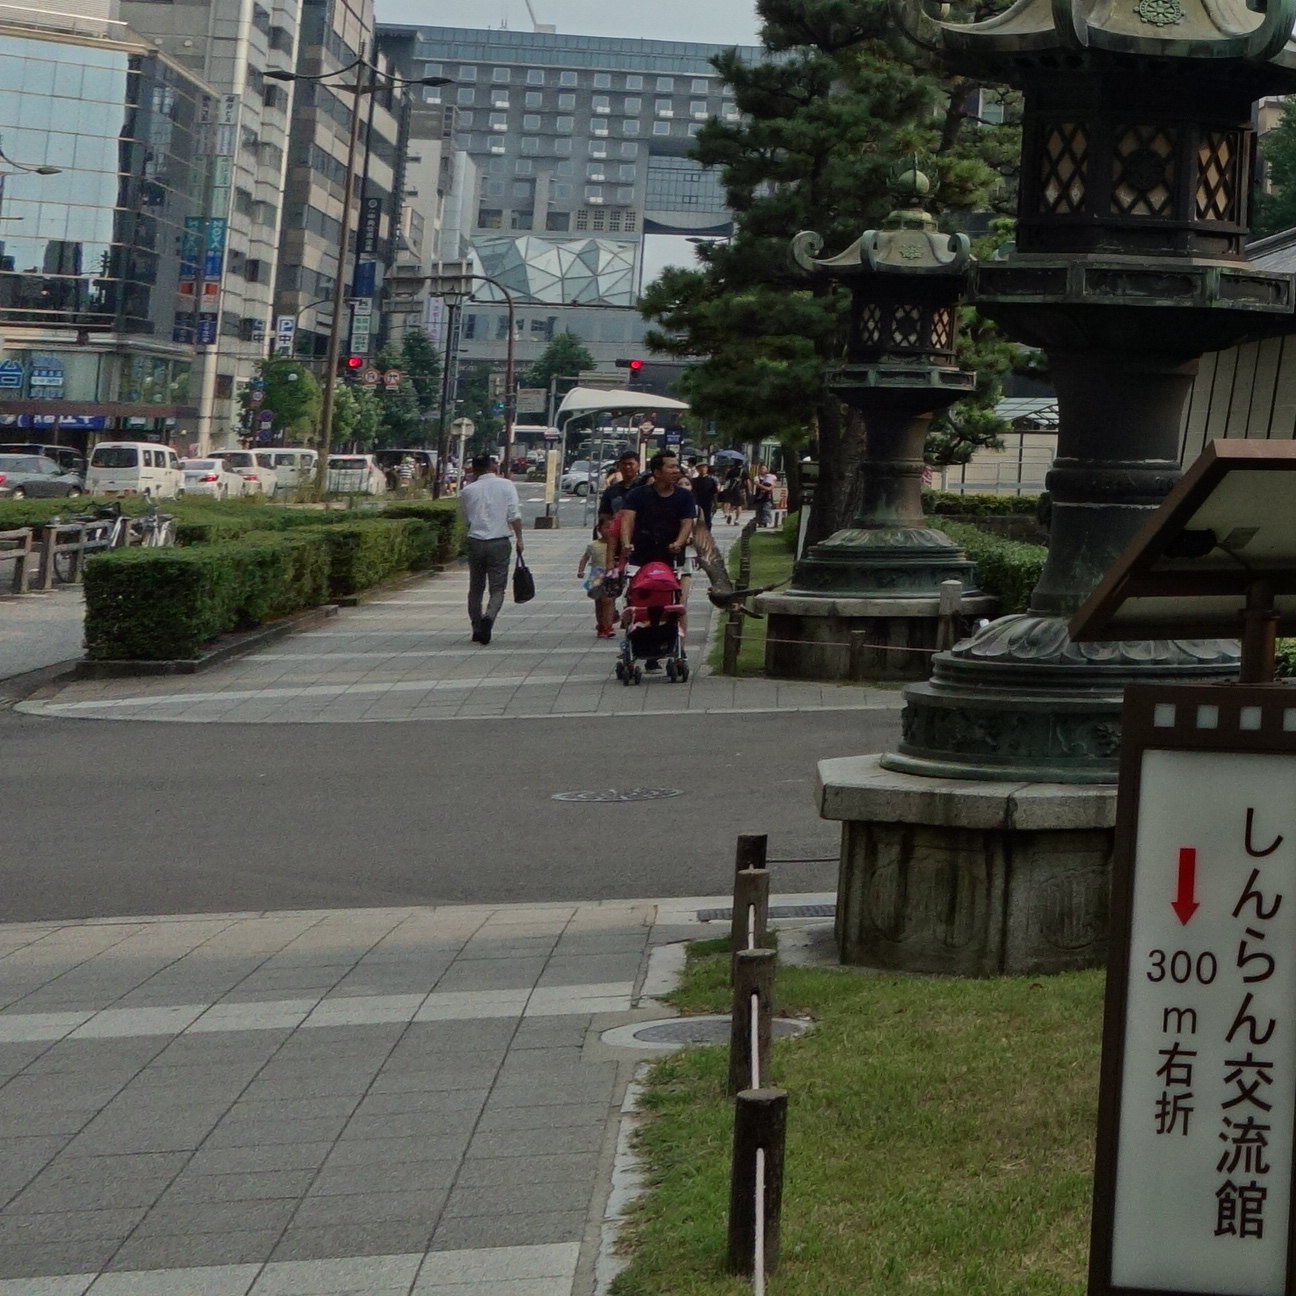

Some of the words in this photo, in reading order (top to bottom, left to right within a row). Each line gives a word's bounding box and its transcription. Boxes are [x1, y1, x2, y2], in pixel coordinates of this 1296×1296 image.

[1213, 806, 1285, 1240] しんらん交流館
